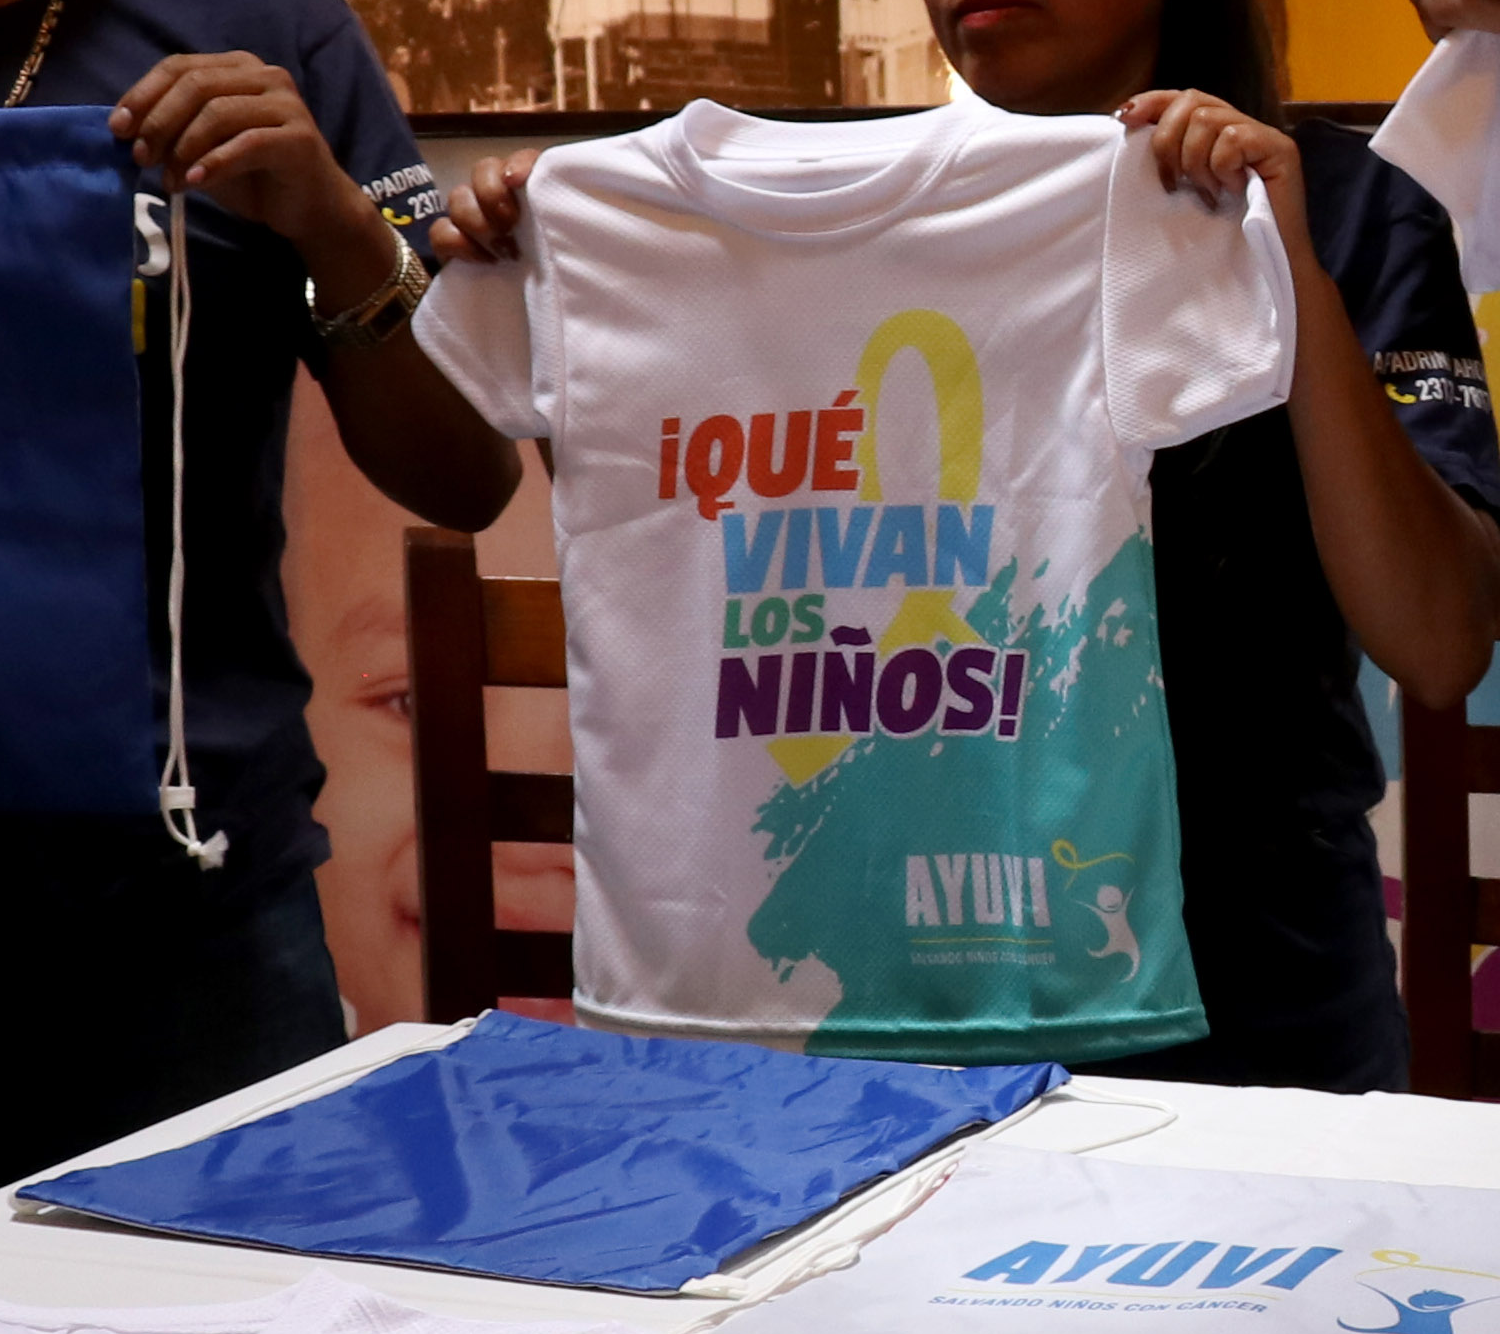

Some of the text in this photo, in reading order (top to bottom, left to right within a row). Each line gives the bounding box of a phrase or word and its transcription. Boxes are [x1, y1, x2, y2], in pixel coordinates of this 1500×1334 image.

[658, 389, 865, 521] ¡QUÉ
[721, 505, 995, 594] VIVAN
[722, 594, 826, 650] LOS
[714, 624, 1027, 740] NIÑOS!
[905, 852, 1051, 927] AYUVI
[960, 1239, 1343, 1291] AYUVI
[928, 1294, 1269, 1314] SALVANDO NIÑOS CON CÁNCER
